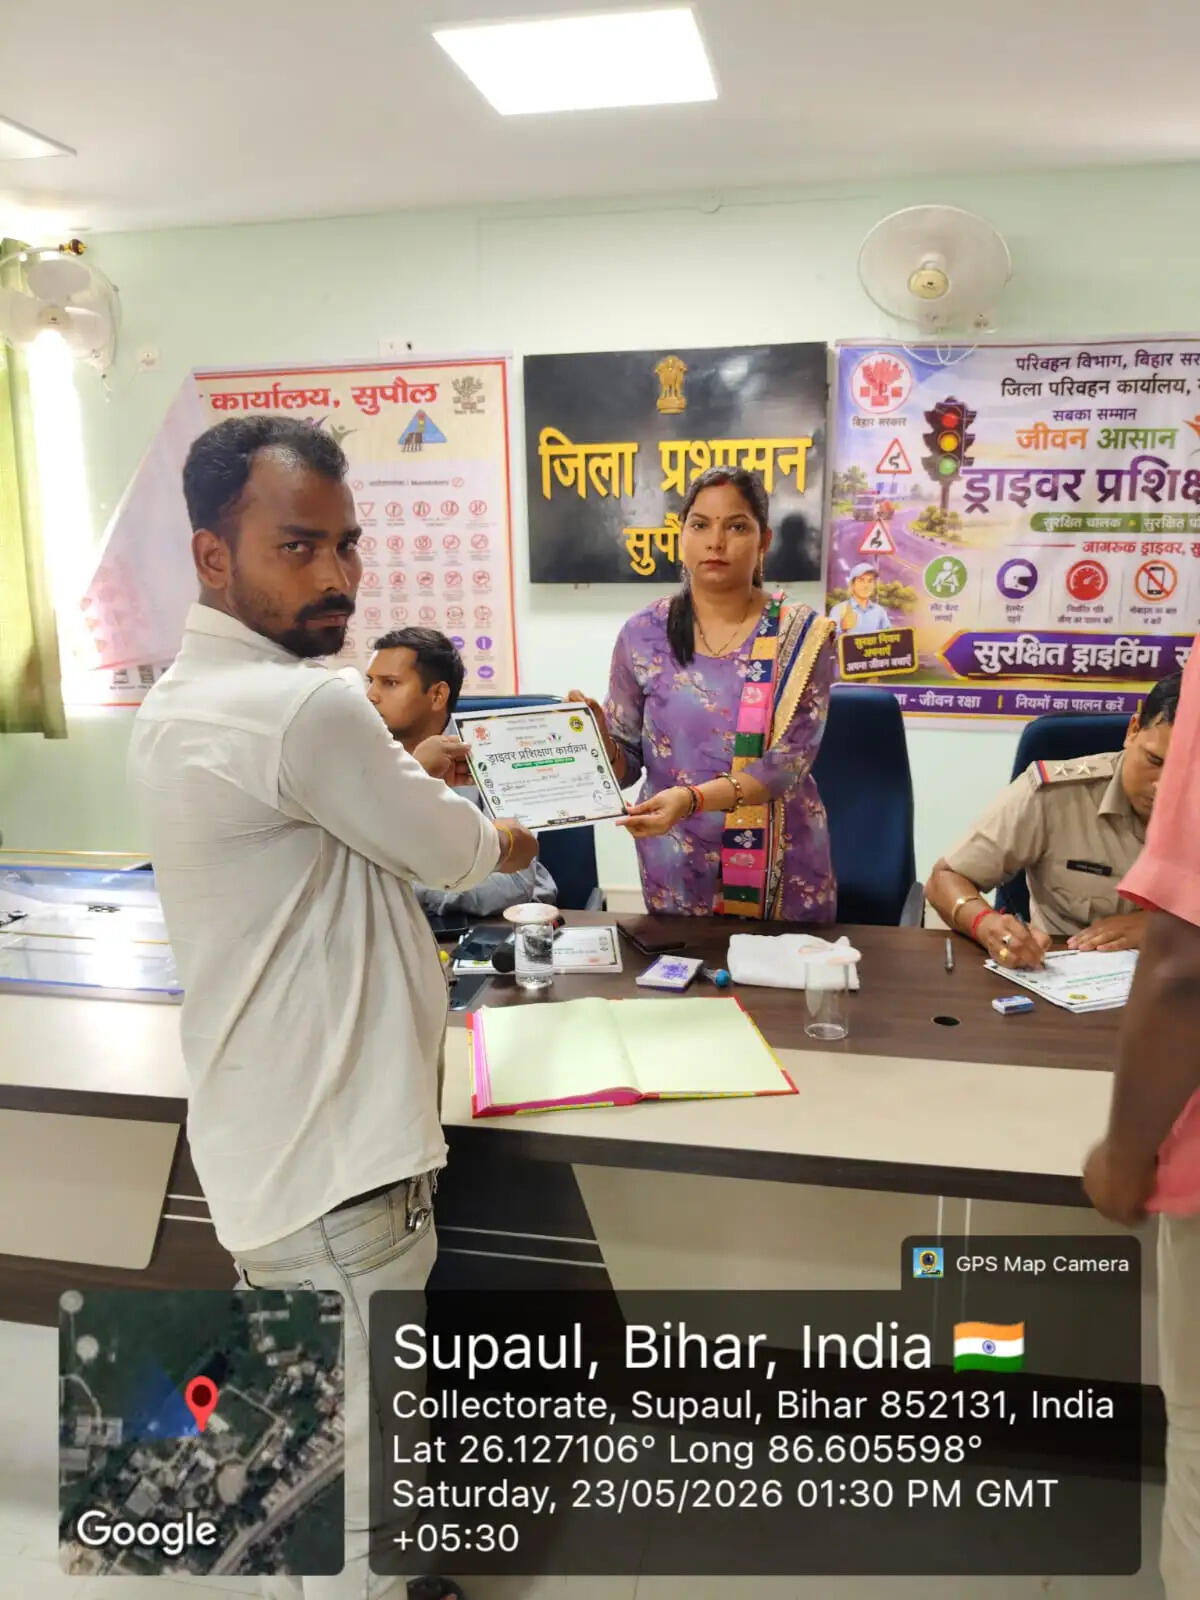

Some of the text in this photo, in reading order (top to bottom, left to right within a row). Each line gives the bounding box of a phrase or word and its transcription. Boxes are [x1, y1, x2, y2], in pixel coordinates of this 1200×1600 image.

[1016, 349, 1200, 372] परिवहन विभाग, बिहार सर
[210, 376, 439, 415] कार्यालय, सुपौल
[1001, 377, 1042, 397] जिला
[1049, 376, 1110, 398] परिवहन
[1116, 372, 1191, 396] कार्यालय,
[1052, 407, 1137, 421] सबका सम्मान
[1016, 421, 1178, 451] जीवन आसान
[538, 426, 639, 500] जिला
[959, 454, 1200, 513] ड्राइवर प्रशिक्ष
[622, 511, 685, 576] सुपौ
[972, 633, 1068, 674] सुरक्षित
[1072, 637, 1162, 673] ड्राइविंग
[919, 689, 954, 707] जीवन
[957, 695, 982, 708] रक्षा
[1015, 693, 1125, 711] नियमों का पालन करें
[486, 751, 517, 766] ड्राइवर
[517, 746, 553, 760] प्रशिक्षण
